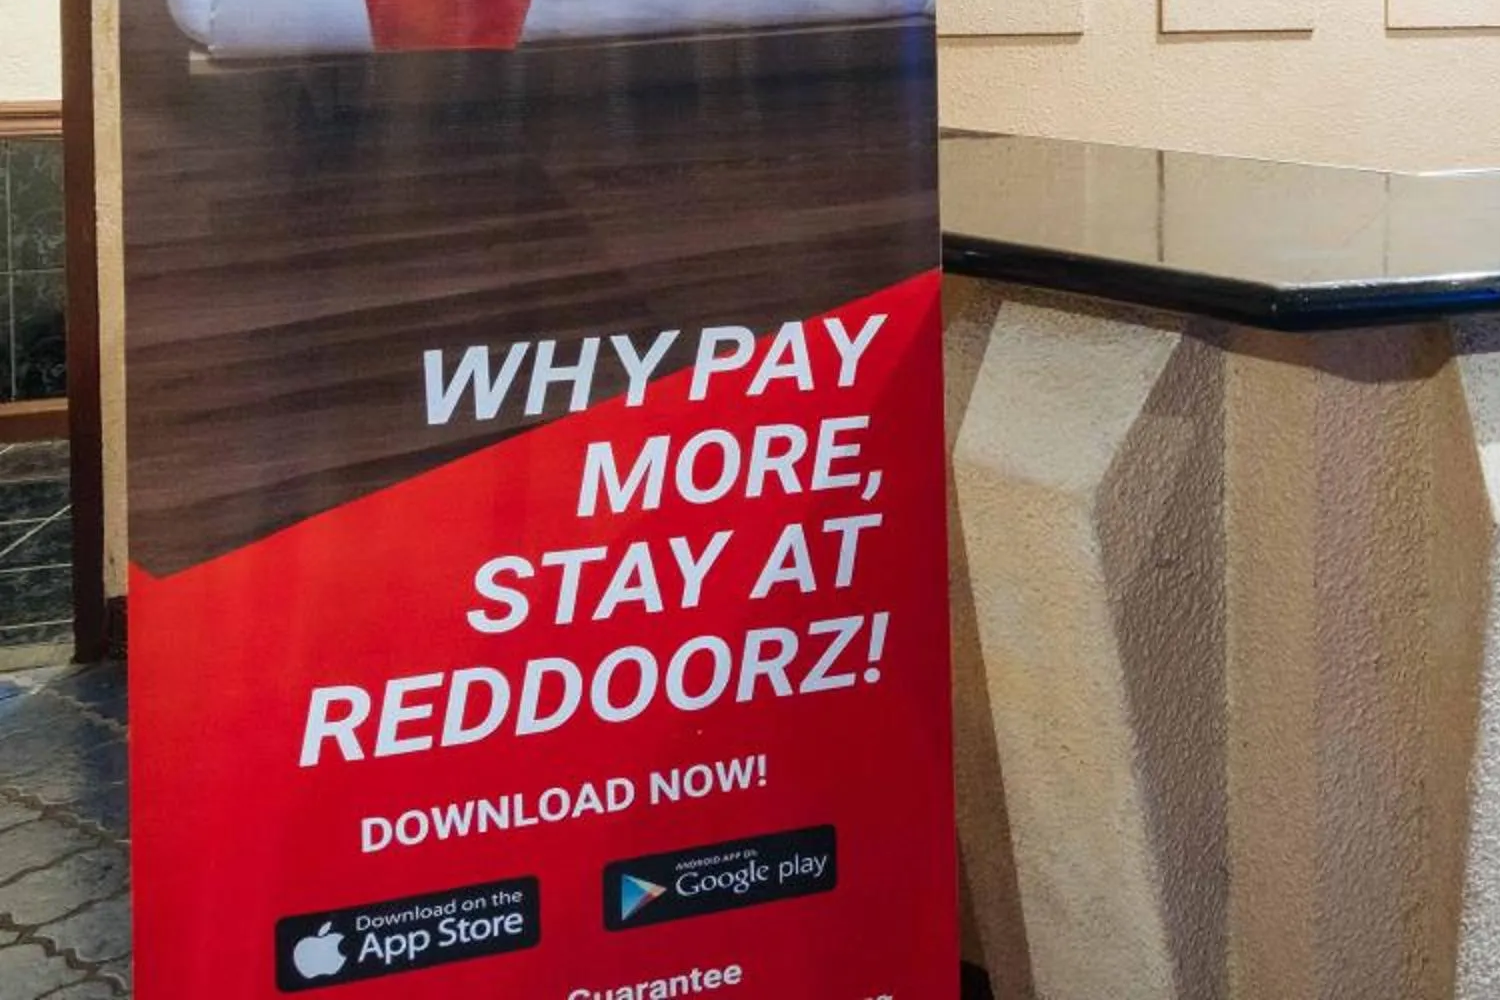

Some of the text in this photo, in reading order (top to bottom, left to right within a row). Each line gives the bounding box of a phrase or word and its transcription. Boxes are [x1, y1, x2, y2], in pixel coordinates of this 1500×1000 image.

[423, 314, 887, 425] WHY PAY
[576, 415, 882, 518] MORE,
[466, 513, 882, 634] STAY AT
[299, 611, 890, 768] REDDOORZ!
[360, 754, 768, 853] DOWNLOAD NOW!
[355, 889, 524, 932] Download on the
[675, 855, 721, 872] ANDROID
[722, 852, 742, 864] APP
[675, 852, 829, 897] Google play
[357, 912, 524, 965] App Store
